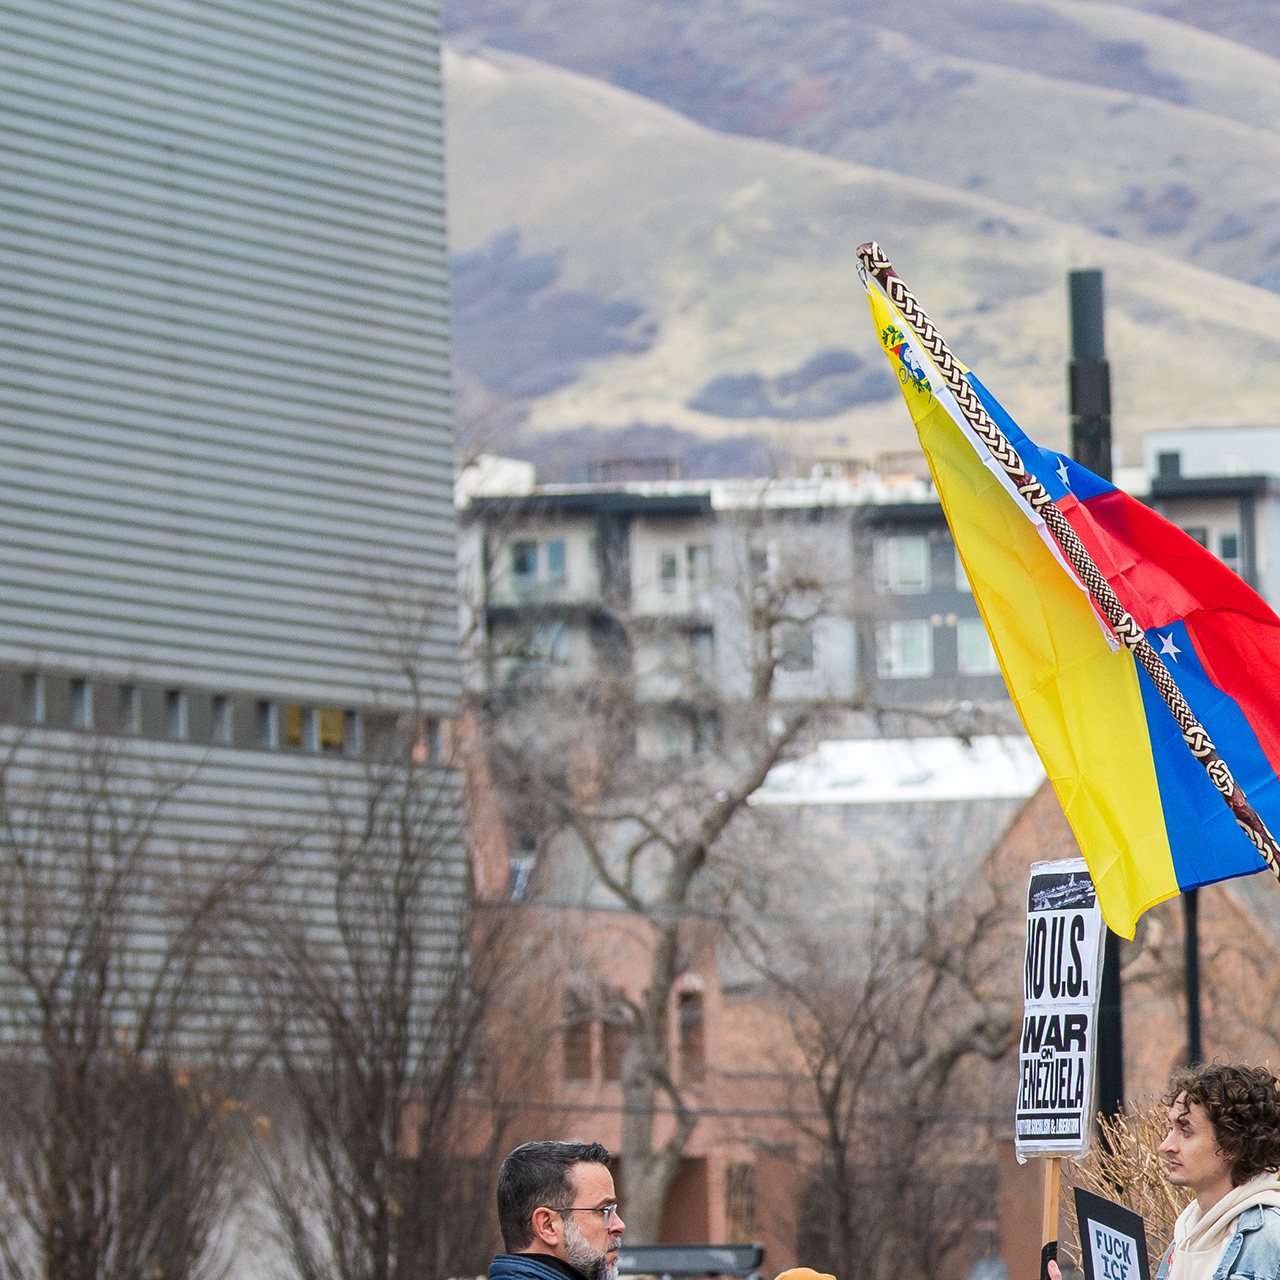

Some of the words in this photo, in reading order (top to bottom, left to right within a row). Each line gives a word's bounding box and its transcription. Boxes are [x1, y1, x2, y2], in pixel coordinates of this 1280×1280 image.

[1026, 916, 1047, 1000] NO
[1049, 914, 1089, 999] U.S.
[1022, 1014, 1088, 1053] WAR
[1041, 1047, 1053, 1060] ON
[1018, 1057, 1084, 1109] ENEZUELA
[1095, 1229, 1132, 1265] FUCK
